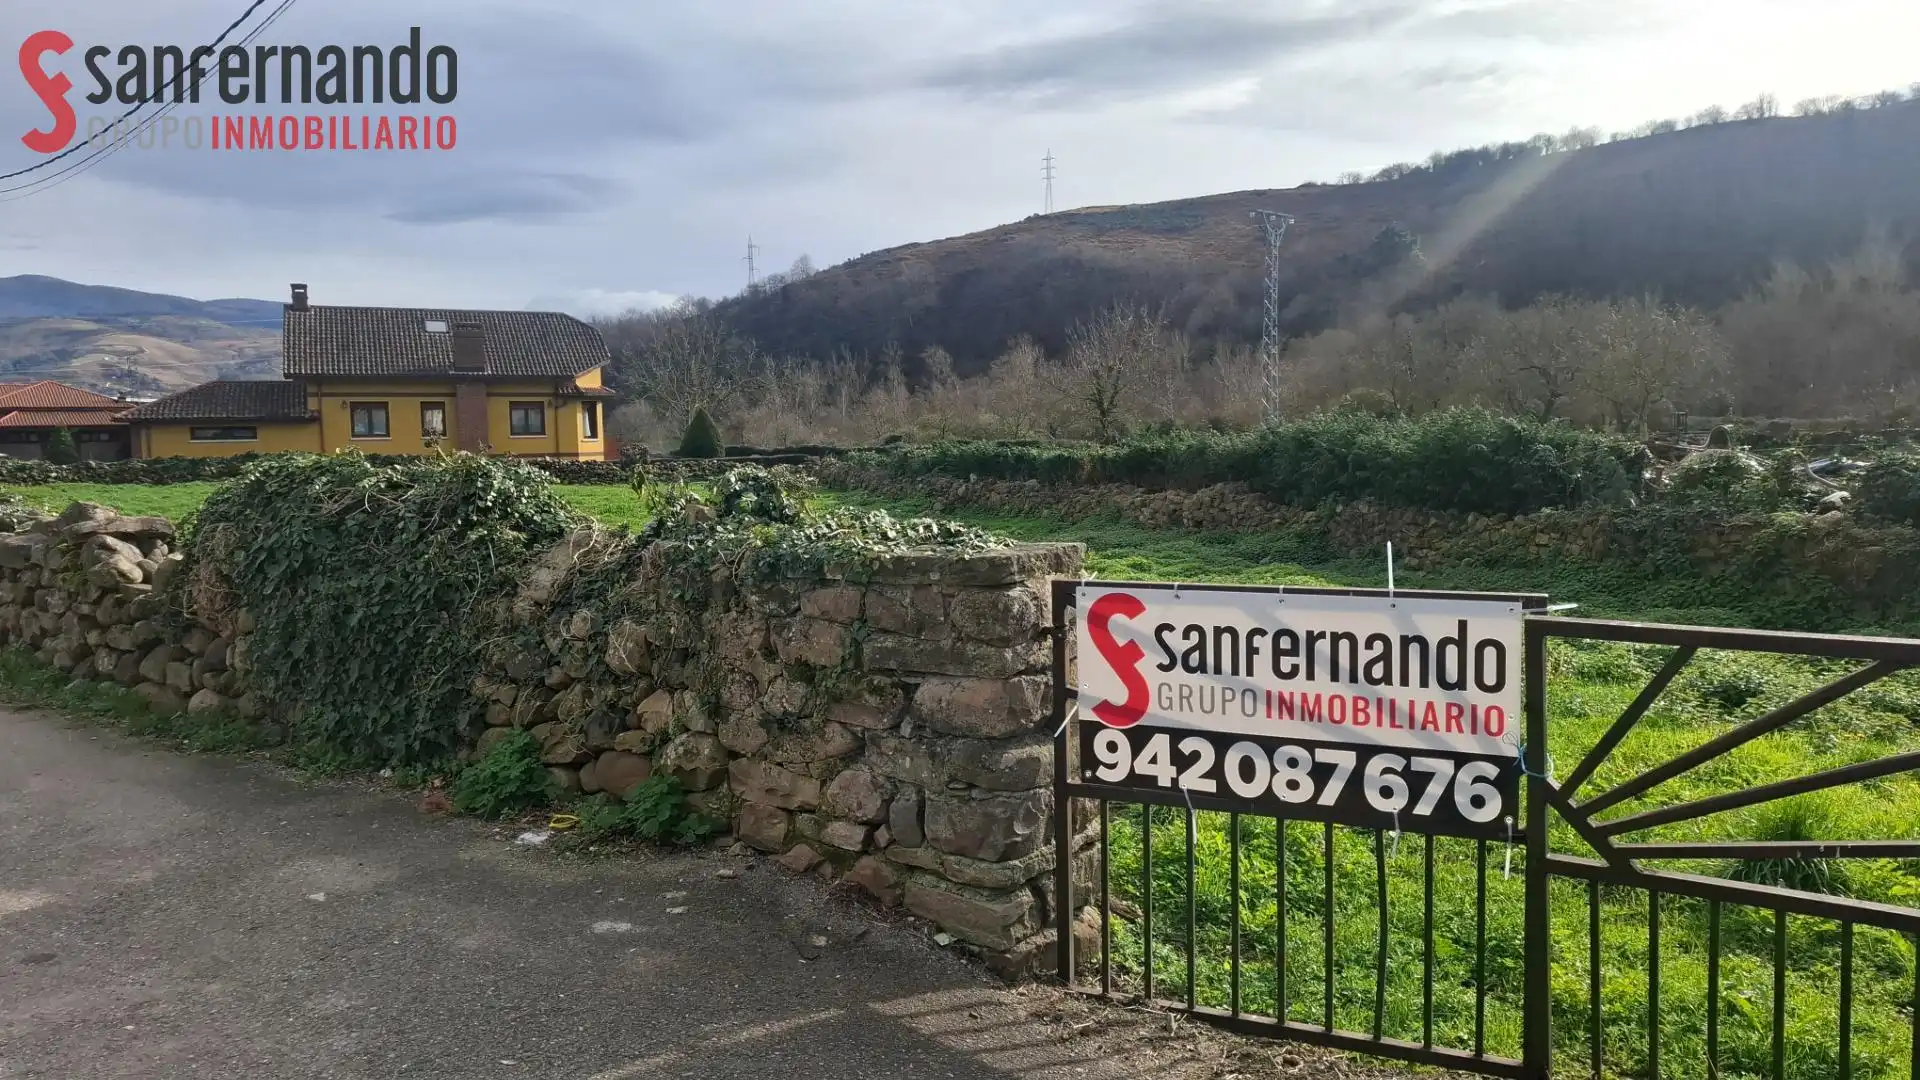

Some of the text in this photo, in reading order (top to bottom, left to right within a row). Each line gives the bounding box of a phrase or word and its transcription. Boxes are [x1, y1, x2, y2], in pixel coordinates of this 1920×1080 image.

[1157, 682, 1506, 738] GRUPO INMOBILIARIO
[1092, 729, 1504, 824] 942 087 676
